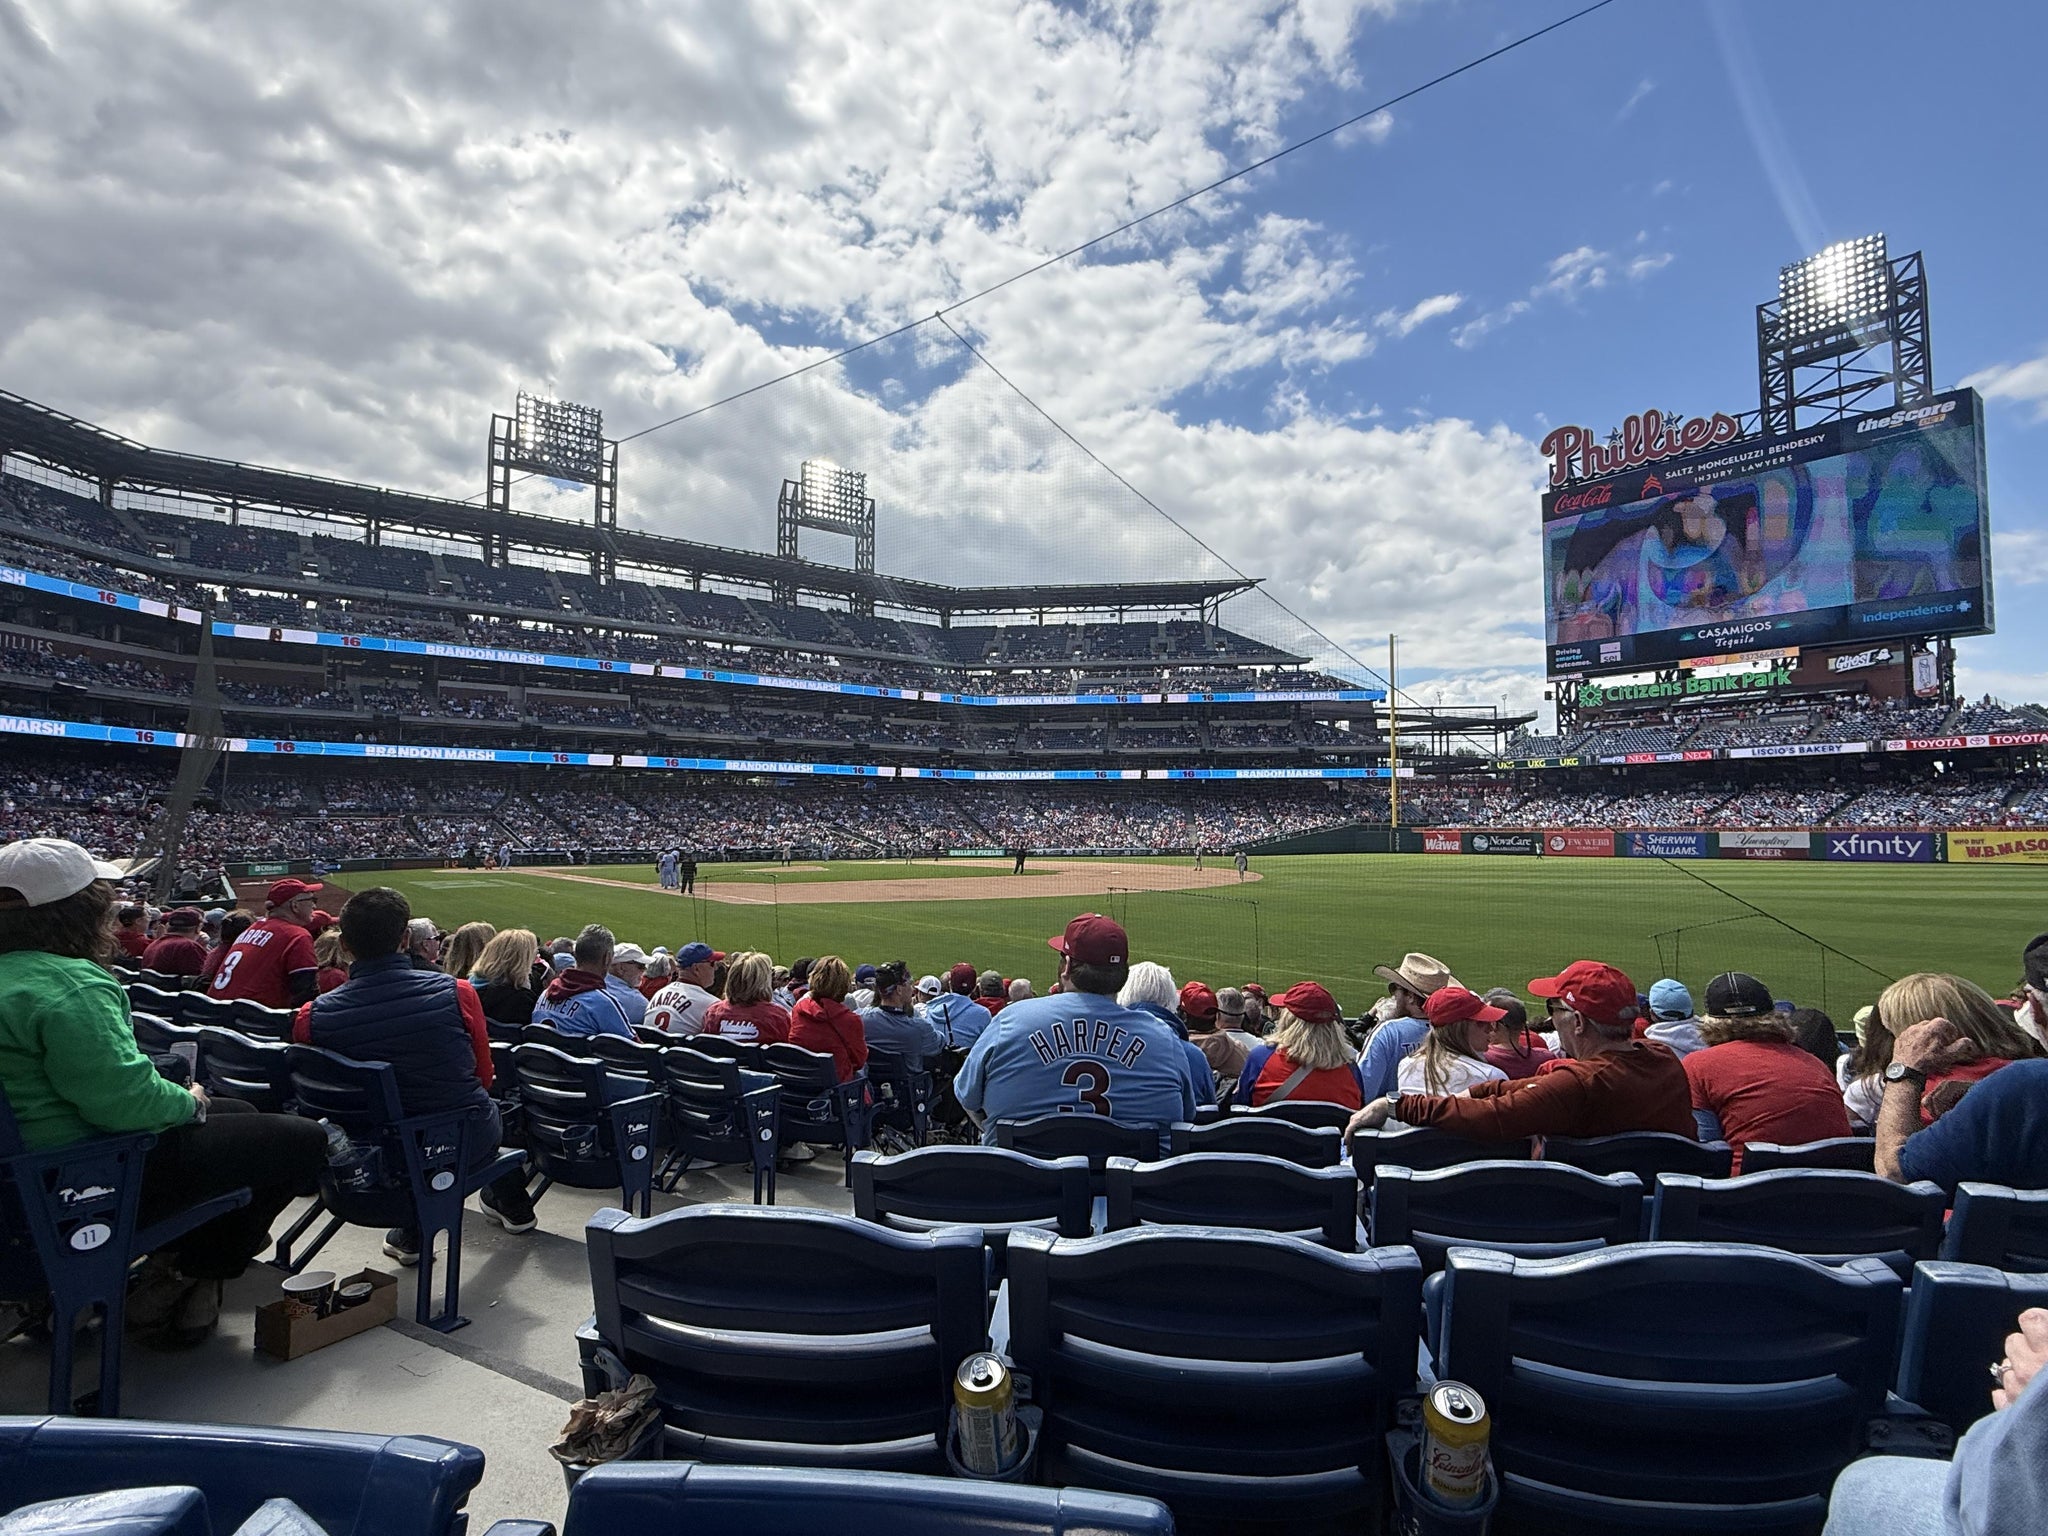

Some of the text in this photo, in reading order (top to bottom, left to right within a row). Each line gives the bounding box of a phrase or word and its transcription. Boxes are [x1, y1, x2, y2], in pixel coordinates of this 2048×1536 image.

[1857, 401, 1956, 433] theScore
[1541, 409, 1738, 486] Phillies
[1665, 433, 1826, 480] SALTZ MONGELUZZI BENDESKY
[1694, 454, 1793, 483] INJURY LAWYERS
[97, 591, 118, 605] 16
[1862, 603, 1953, 623] Independence
[1698, 621, 1772, 639] CASAMIGOS
[0, 633, 53, 654] ILLIES
[340, 635, 361, 647] 16
[1715, 634, 1754, 648] Tequila
[426, 644, 545, 665] BRANDON MARSH
[1835, 649, 1879, 672] GHOST
[597, 661, 613, 671] 16
[701, 671, 716, 681] 16
[758, 677, 841, 693] BRANDON MARSH
[1606, 667, 1792, 701] Citizens Bank Park
[878, 688, 889, 696] 16
[1201, 694, 1214, 702] 16
[951, 695, 962, 703] 16
[1115, 695, 1127, 703] 16
[0, 717, 66, 736] MARSH
[135, 731, 155, 743] 16
[1994, 733, 2048, 744] TOYOTA
[273, 741, 296, 753] 16
[1751, 743, 1842, 756] LISCIO'S BAKERY
[1910, 738, 1962, 749] TOYOTA
[365, 743, 495, 760] BRANDON MARSH
[1626, 753, 1655, 762] NECA
[1684, 751, 1712, 760] NECA
[553, 753, 569, 763] 16
[664, 758, 679, 767] 16
[1527, 759, 1546, 768] UKG
[1559, 757, 1578, 767] UKG
[725, 760, 813, 773] BRANDON MARSH
[852, 766, 864, 775] 16
[1496, 761, 1515, 769] UKG
[931, 769, 942, 777] 16
[974, 770, 1055, 779] BRANDON MARSH
[1094, 771, 1107, 779] 16
[1236, 769, 1322, 778] BRANDON MARSH
[1364, 769, 1378, 777] 16
[1425, 839, 1459, 851] Wawa
[1490, 835, 1531, 846] NovaCare
[1585, 838, 1610, 847] WEBB
[1647, 834, 1696, 845] SHERWIN
[1735, 833, 1792, 847] Yuengling
[1832, 834, 1922, 858] xfinity
[1746, 848, 1782, 857] LAGER
[214, 951, 243, 990] 3
[1028, 1018, 1146, 1069] HARPER
[1058, 1060, 1112, 1117] 3
[82, 1229, 96, 1245] 11
